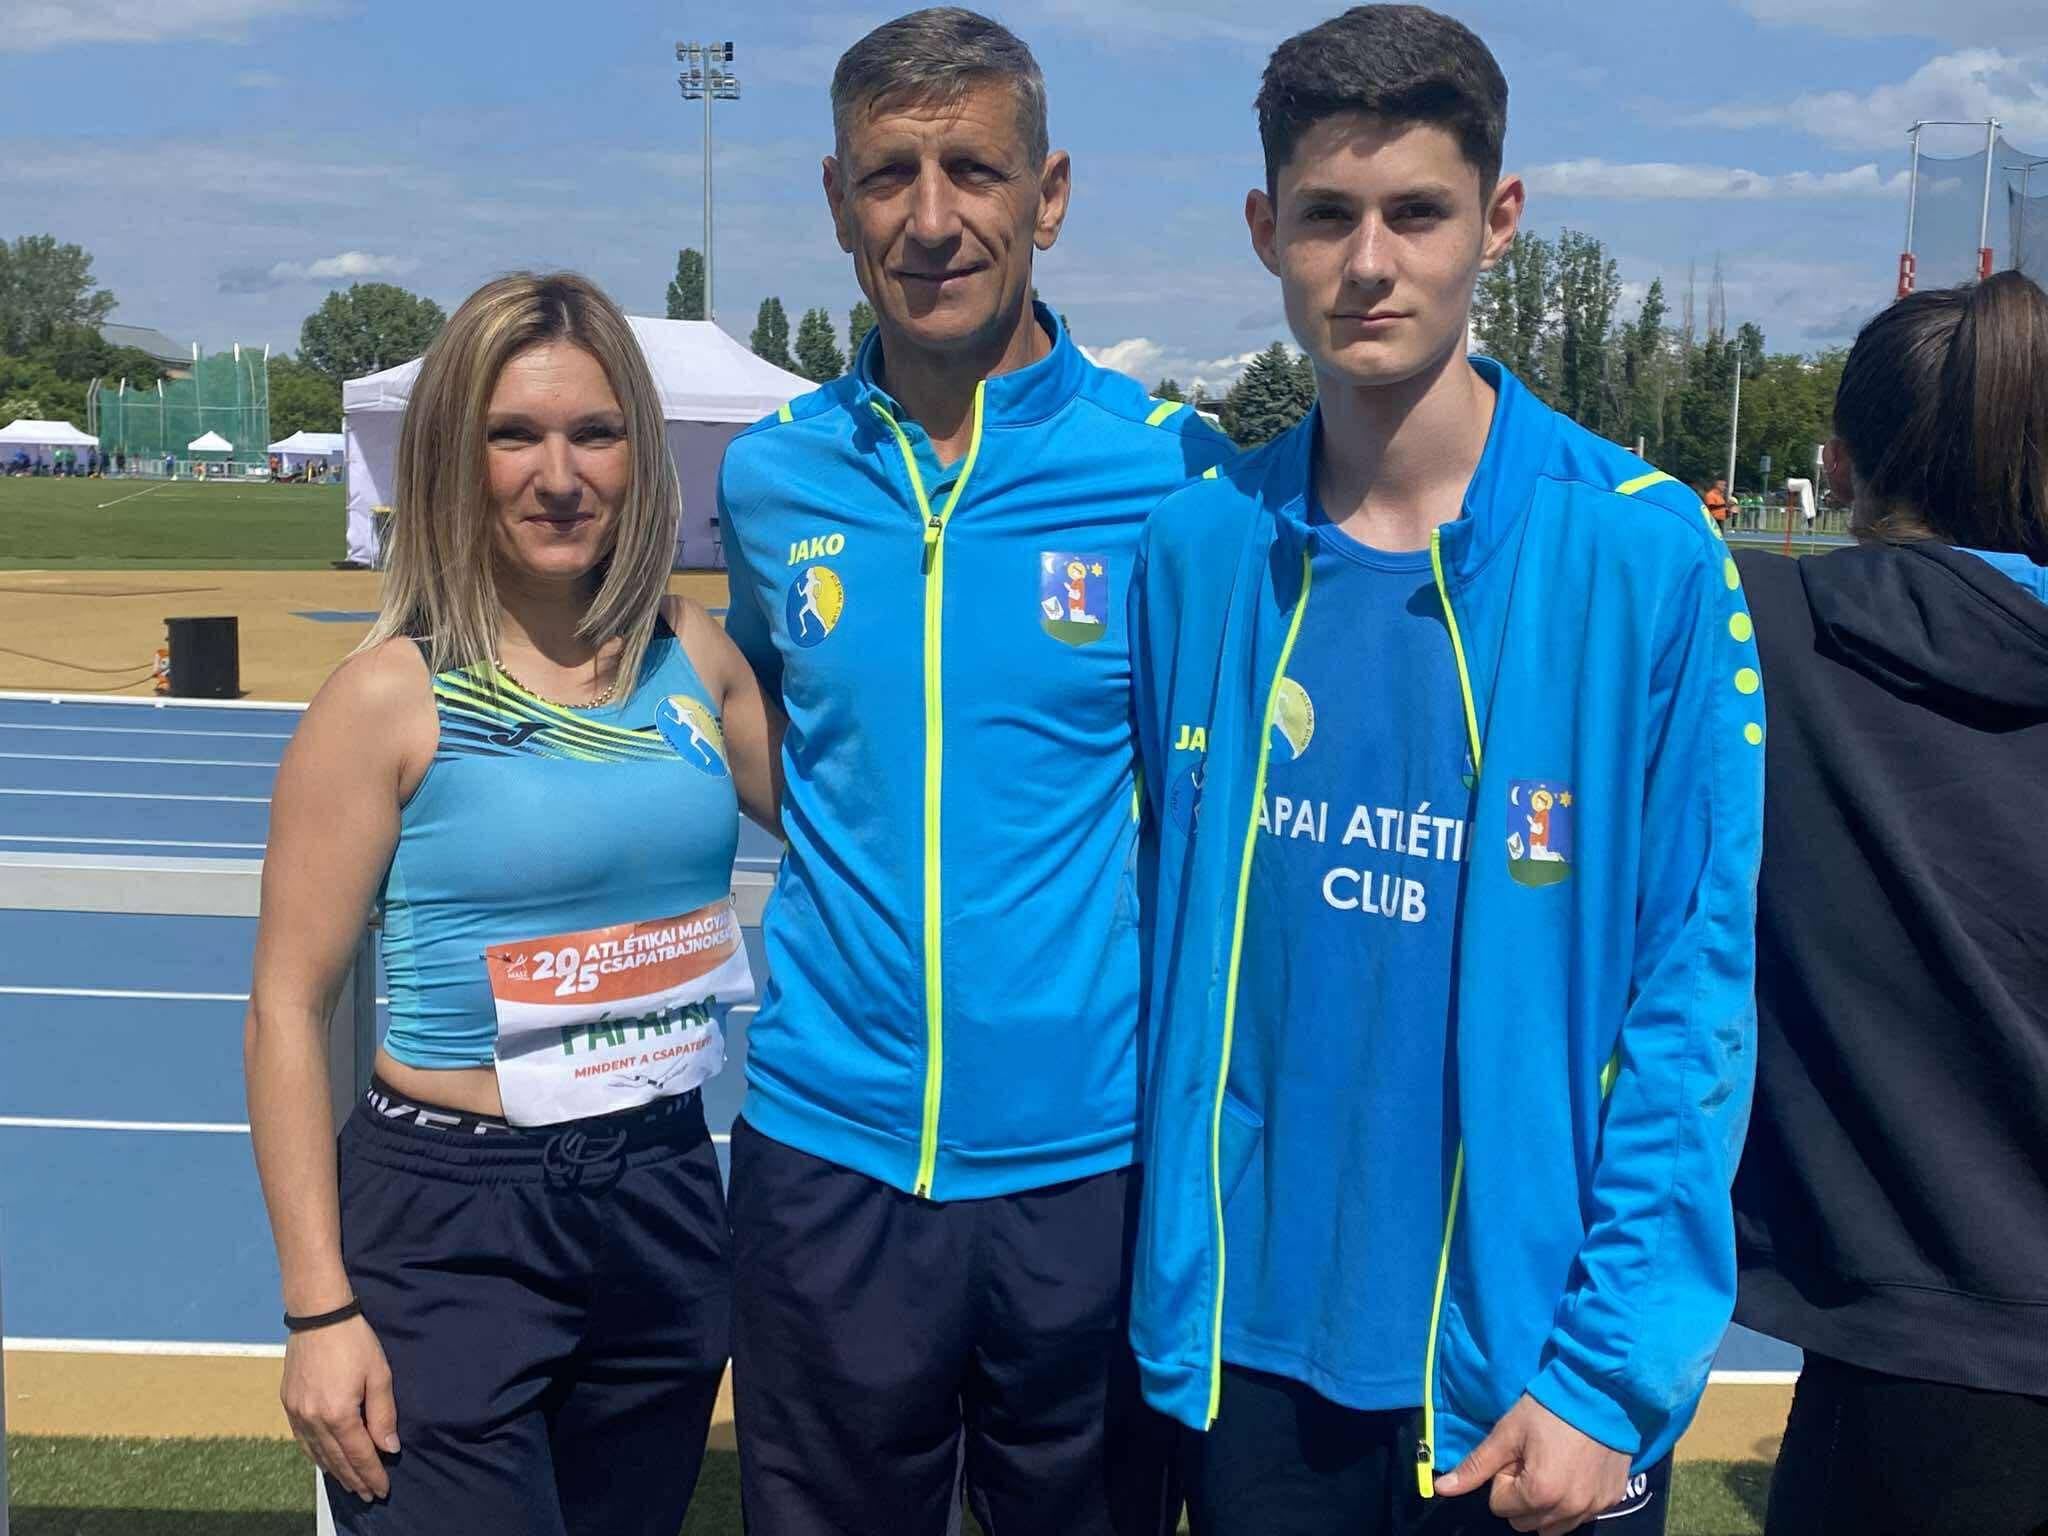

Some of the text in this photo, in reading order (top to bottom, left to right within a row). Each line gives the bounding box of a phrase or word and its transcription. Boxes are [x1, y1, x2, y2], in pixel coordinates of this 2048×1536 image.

[787, 533, 845, 566] JAKO
[1175, 724, 1206, 753] JA
[1257, 782, 1471, 862] ÁPAI ATLÉTI
[1322, 867, 1427, 923] CLUB
[584, 930, 677, 961] ATLÉTIKAI
[532, 947, 581, 981] 20
[555, 963, 600, 997] 25
[574, 1057, 637, 1079] MINDENT
[640, 1055, 649, 1067] A
